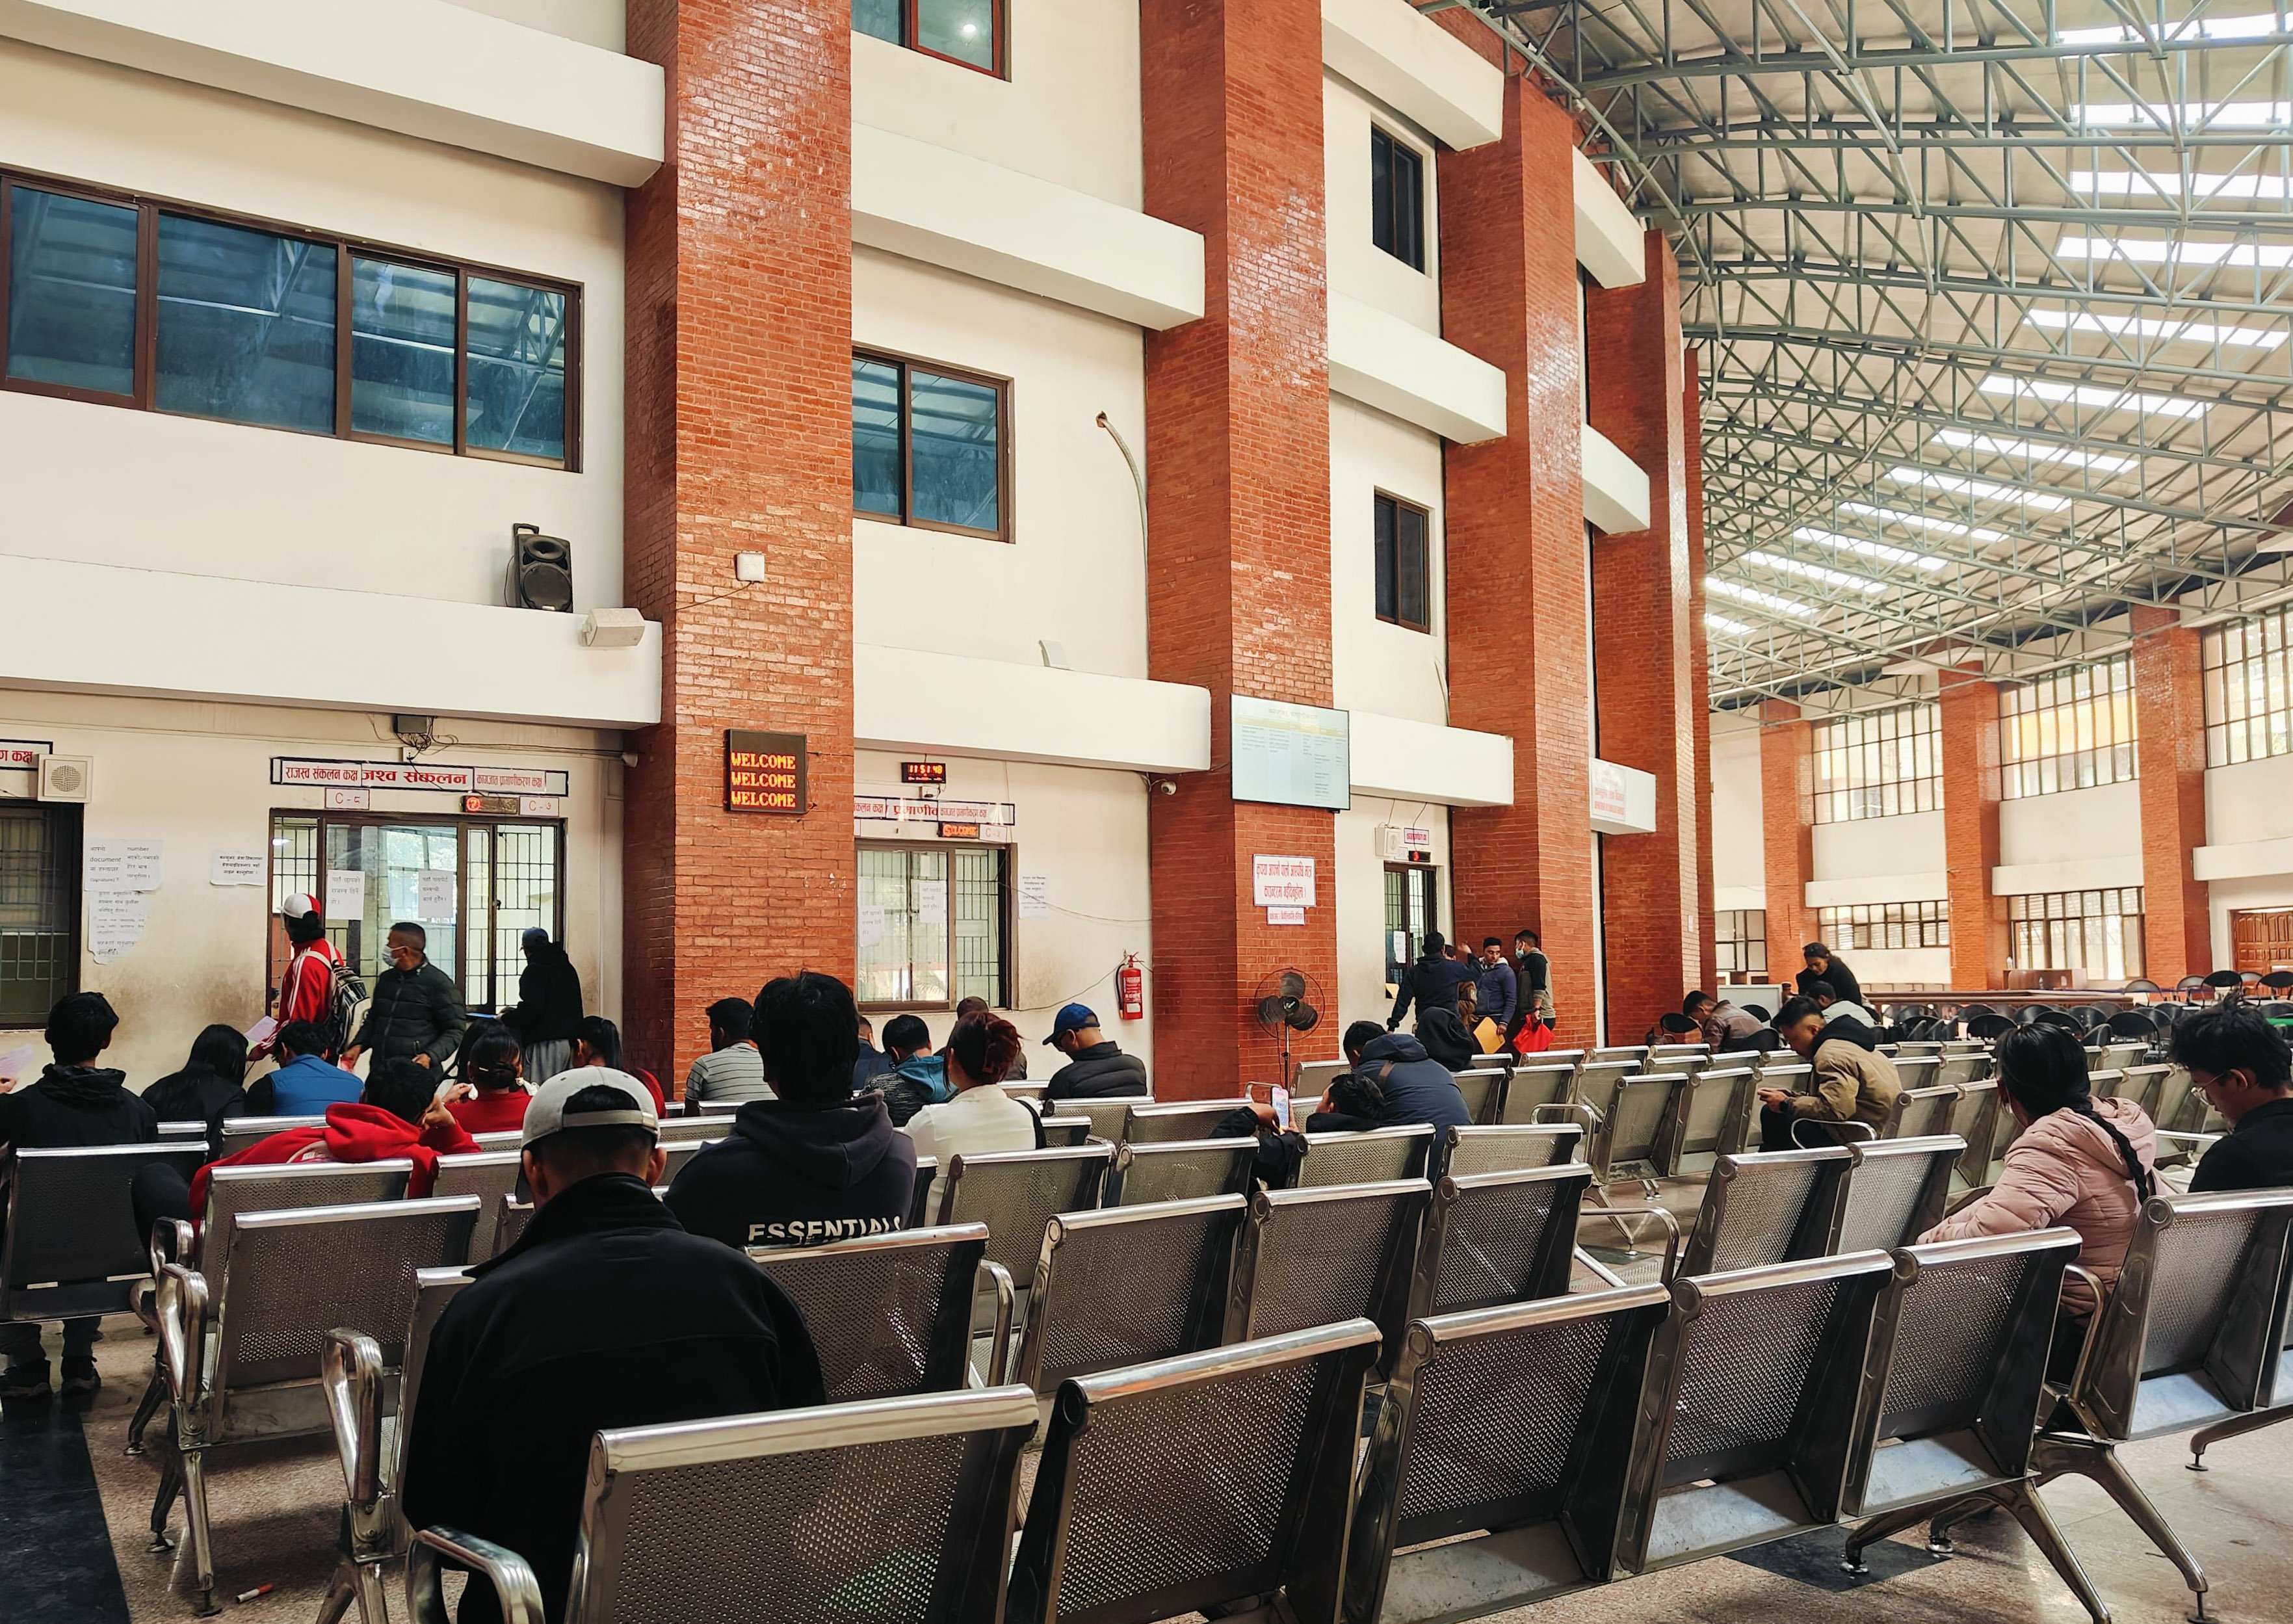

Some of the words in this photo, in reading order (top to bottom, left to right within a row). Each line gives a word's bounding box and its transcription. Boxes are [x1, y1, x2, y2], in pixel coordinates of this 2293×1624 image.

[12, 750, 33, 764] कक्ष
[731, 752, 796, 770] WELCOME
[285, 766, 310, 779] राजस्व
[312, 766, 341, 780] संकलन
[343, 769, 358, 782] कक्ष
[362, 770, 397, 781] जश्व
[731, 771, 796, 789] WELCOME
[731, 791, 796, 807] WELCOME
